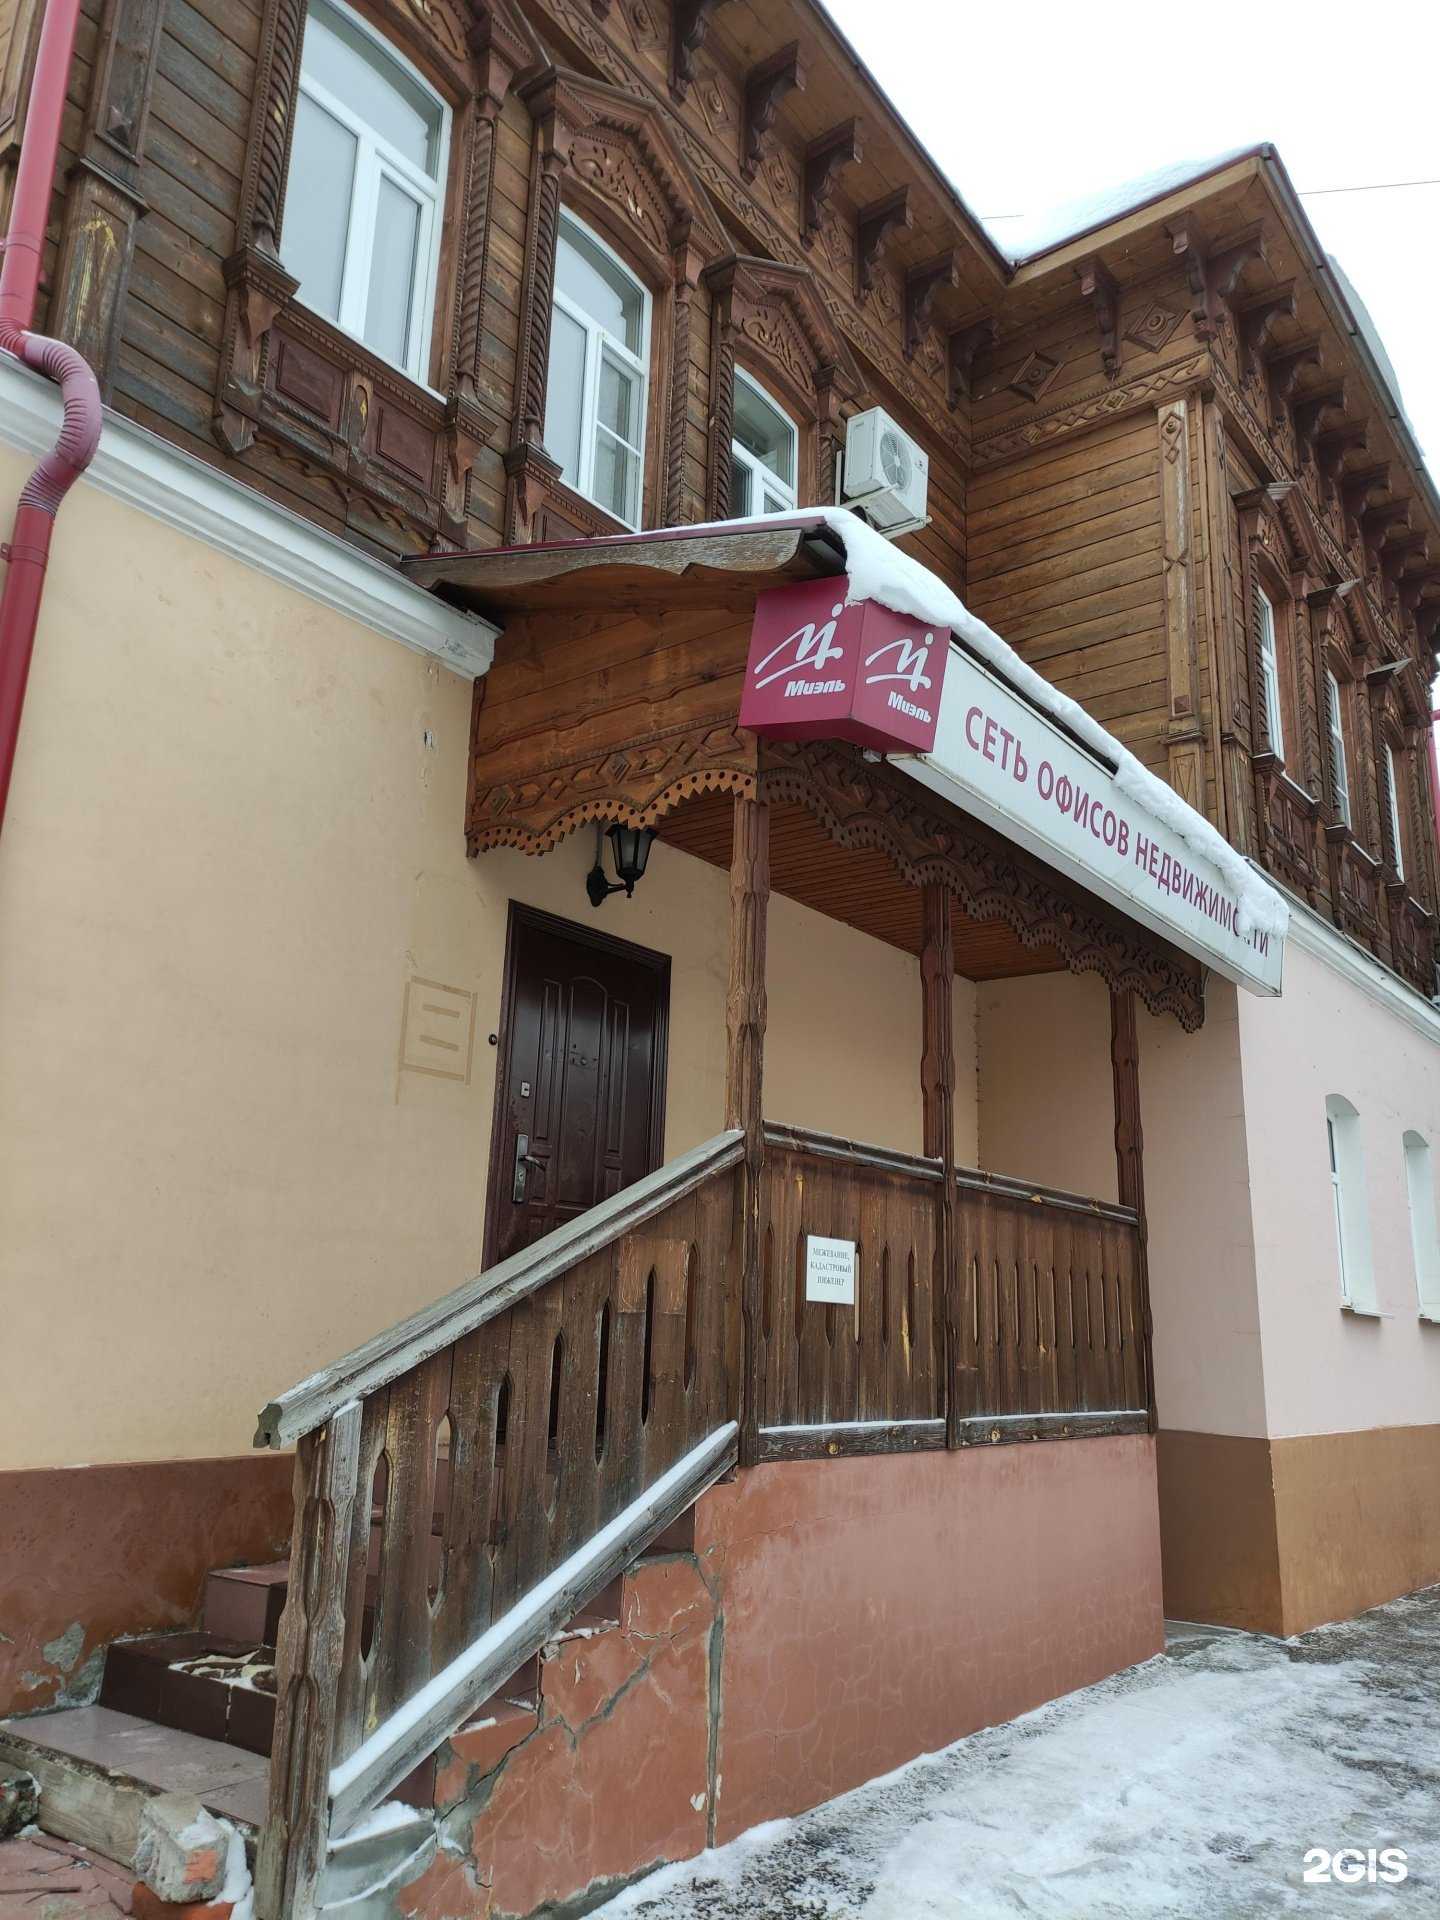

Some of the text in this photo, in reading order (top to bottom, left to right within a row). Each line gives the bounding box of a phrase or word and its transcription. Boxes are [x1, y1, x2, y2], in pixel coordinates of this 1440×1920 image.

[784, 679, 846, 697] Миэль
[888, 691, 932, 723] Миэль
[965, 706, 1269, 957] СЕТЬ ОФИСОВ НЕДВИЖИМТИ
[818, 1276, 845, 1286] ИНЖЕНЕР
